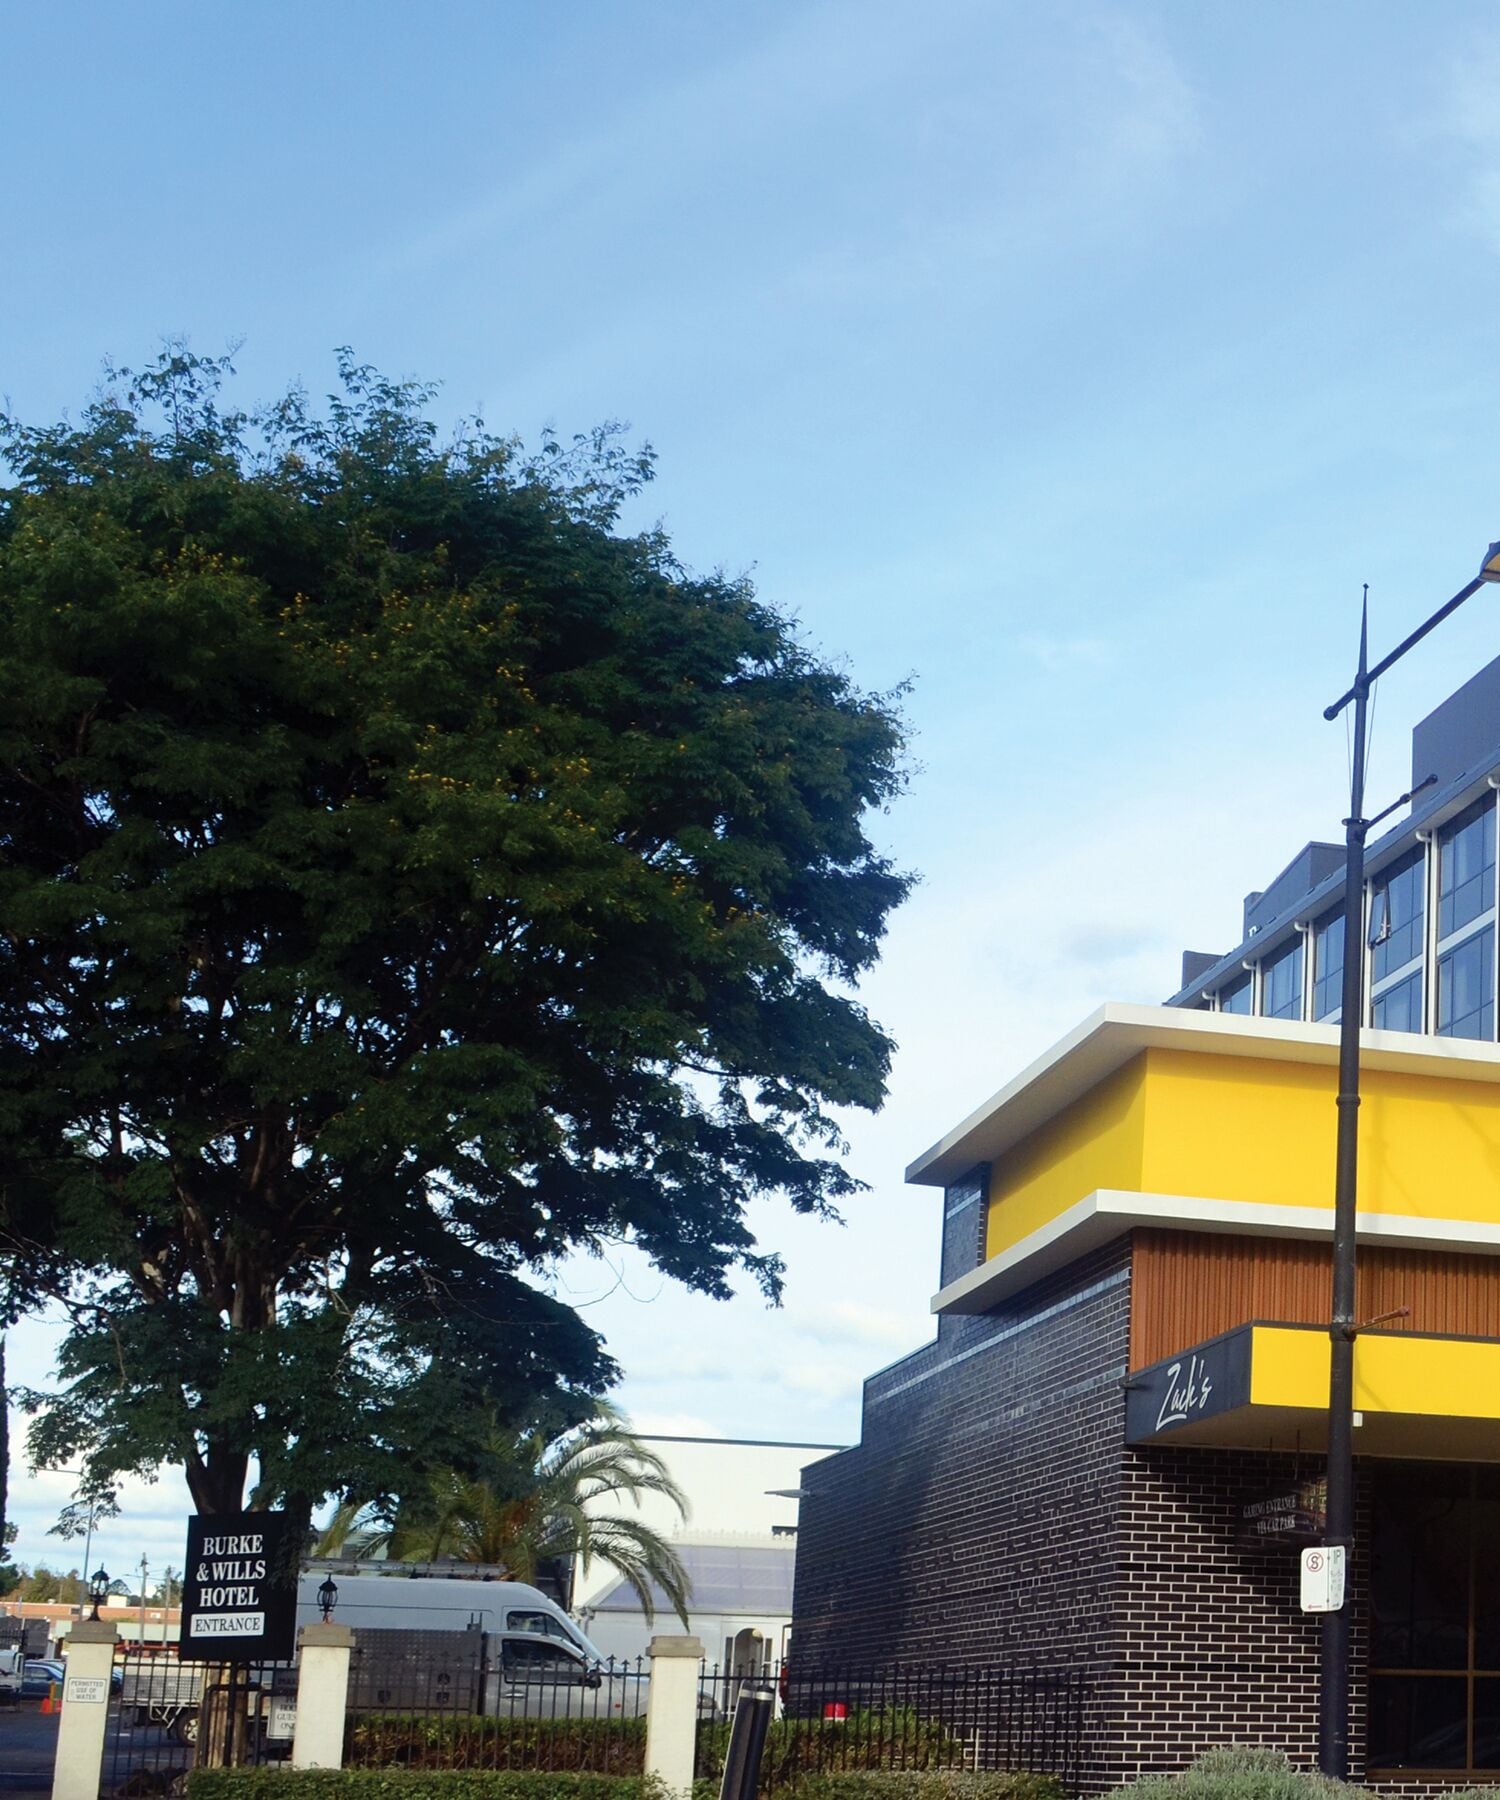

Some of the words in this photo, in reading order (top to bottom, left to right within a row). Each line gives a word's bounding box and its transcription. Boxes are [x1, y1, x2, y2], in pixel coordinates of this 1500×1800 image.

[1155, 1355, 1213, 1432] Zack's
[1266, 1494, 1297, 1515] ENTRANCE
[1267, 1517, 1280, 1533] CAR
[1280, 1514, 1296, 1531] PARK
[202, 1534, 263, 1556] BURKE
[196, 1562, 209, 1582] &
[211, 1560, 266, 1581] WILLS
[199, 1586, 259, 1607] HOTEL
[194, 1617, 261, 1632] ENTRANCE
